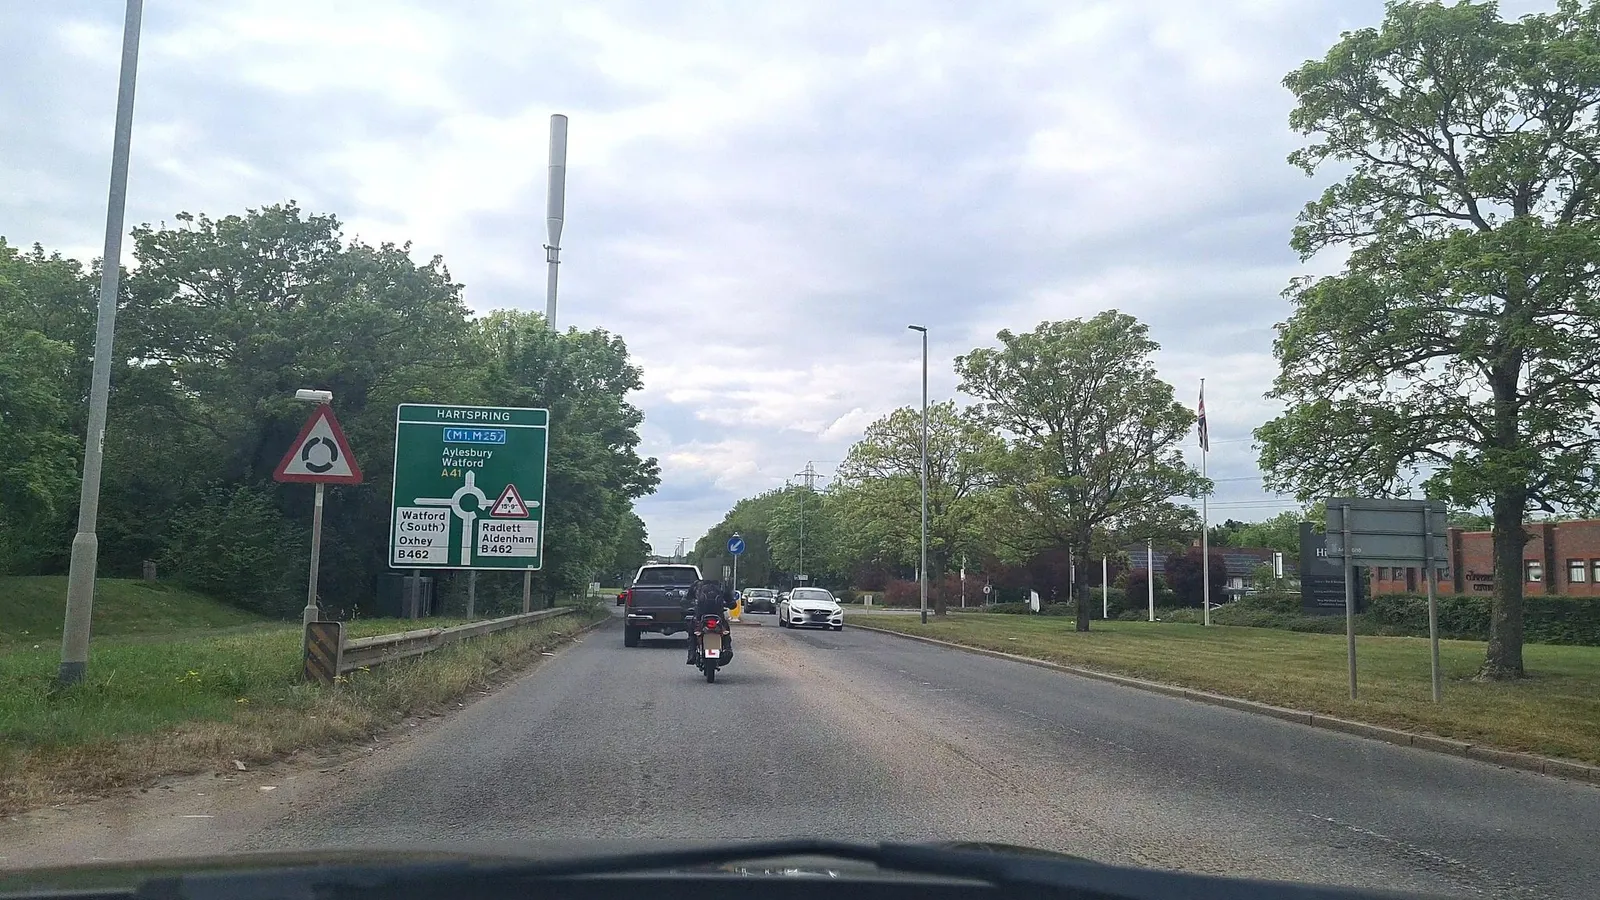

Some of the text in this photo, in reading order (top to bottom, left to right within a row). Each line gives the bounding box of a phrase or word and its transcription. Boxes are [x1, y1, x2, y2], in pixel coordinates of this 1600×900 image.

[437, 409, 510, 421] HARTSPRING
[442, 447, 493, 459] Aylesbury
[441, 458, 484, 468] Watford
[402, 511, 446, 521] Watford
[399, 522, 446, 533] (South)
[482, 523, 521, 533] Radlett
[399, 536, 433, 547] Oxhey
[482, 534, 534, 544] Aldenham
[398, 550, 429, 560] B462
